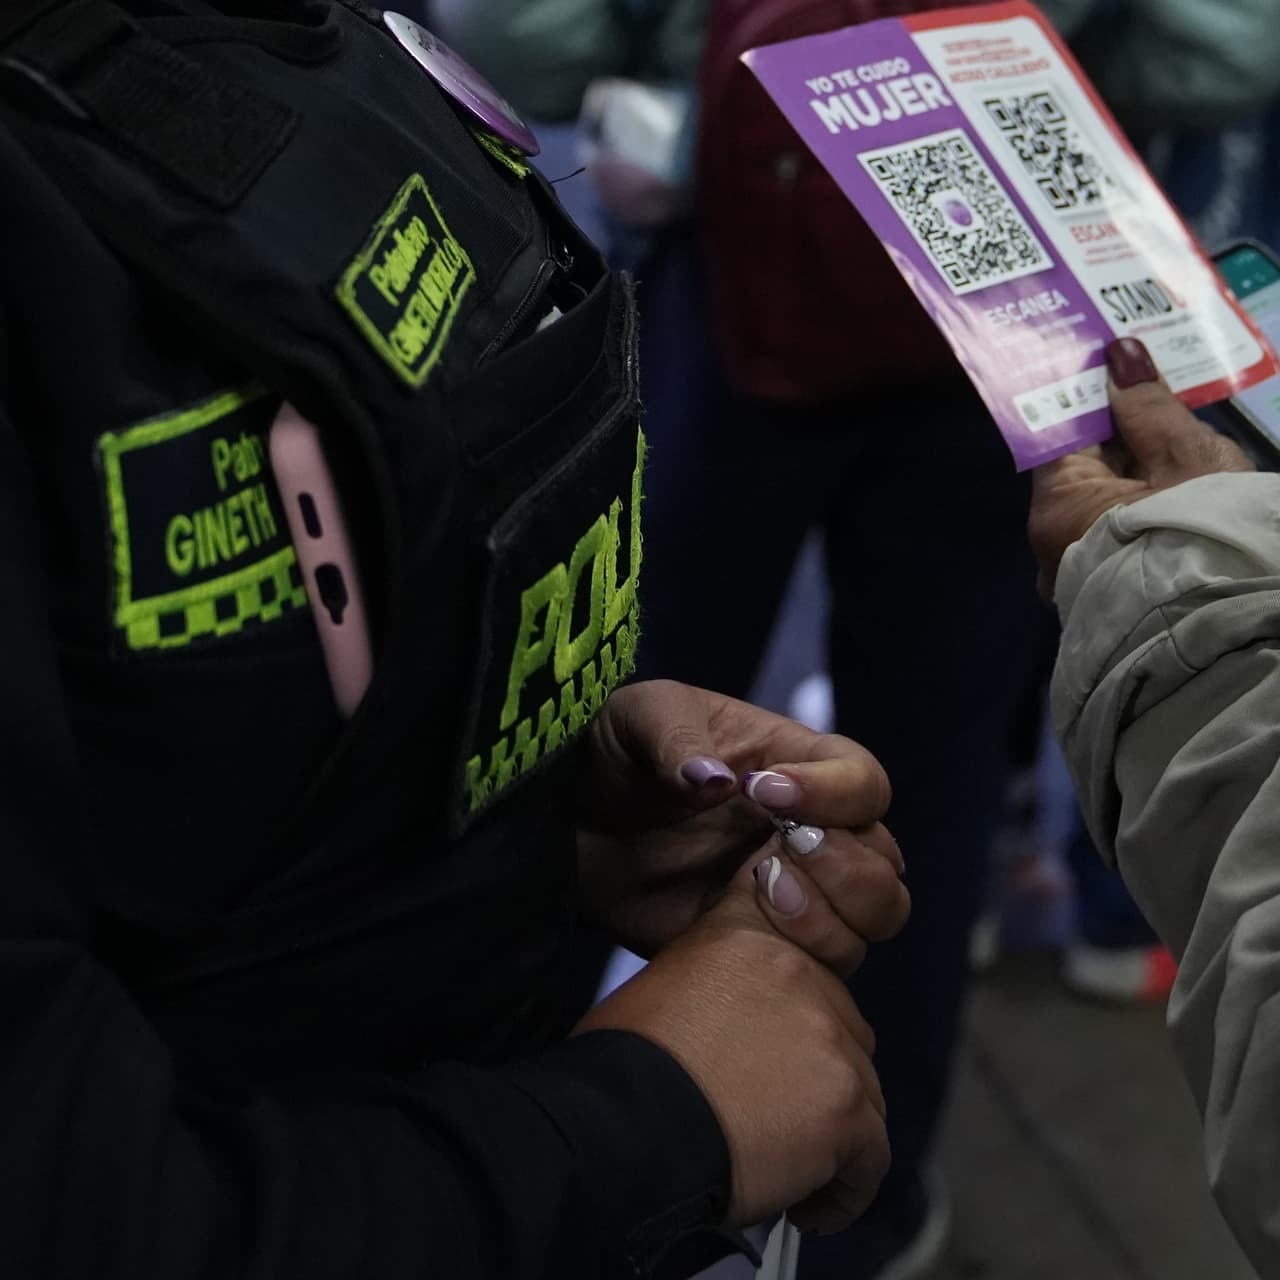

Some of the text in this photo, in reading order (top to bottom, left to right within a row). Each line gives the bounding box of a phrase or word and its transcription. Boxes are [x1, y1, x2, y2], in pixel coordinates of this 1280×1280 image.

[805, 56, 911, 95] YO TE CUIDO
[809, 72, 953, 134] MUJER
[1099, 278, 1172, 323] STAND
